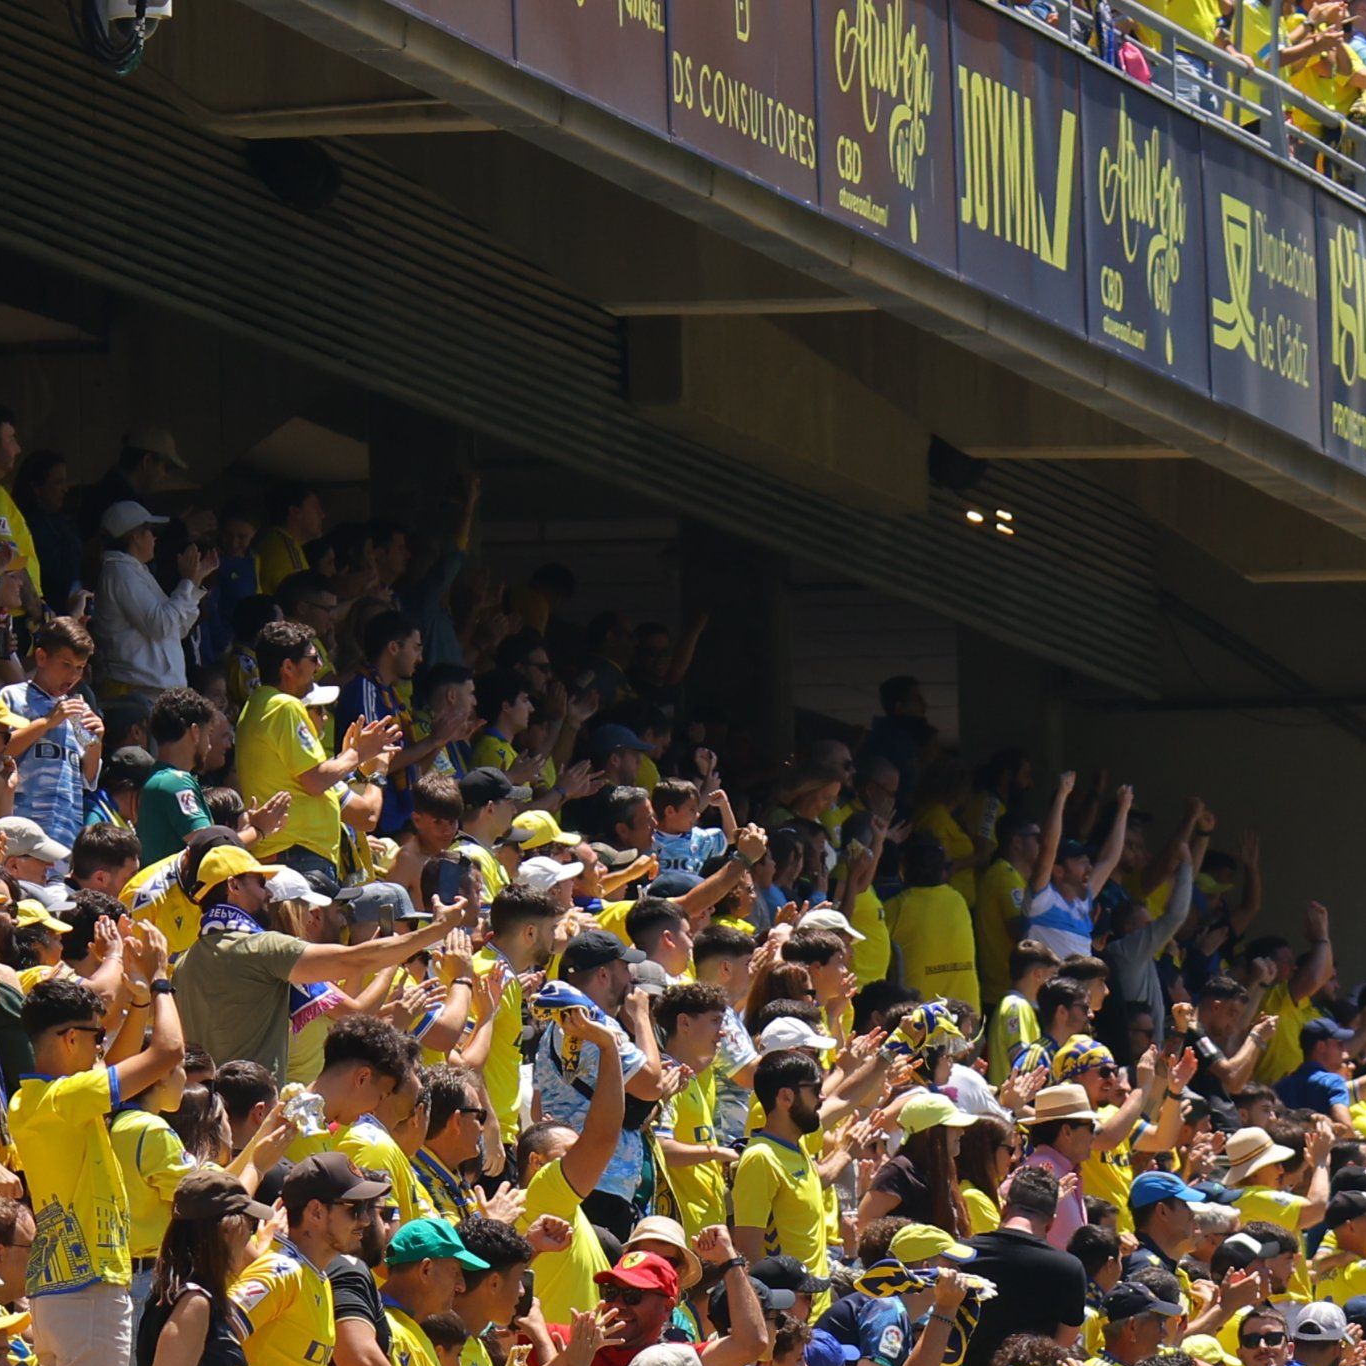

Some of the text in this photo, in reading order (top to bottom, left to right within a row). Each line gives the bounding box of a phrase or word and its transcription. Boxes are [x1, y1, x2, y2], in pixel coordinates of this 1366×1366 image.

[672, 50, 816, 170] DS CONSULTORES
[837, 135, 862, 184] CBD
[1100, 265, 1124, 312] CBD
[1255, 209, 1317, 299] Diputación
[1259, 306, 1310, 389] de Cádiz
